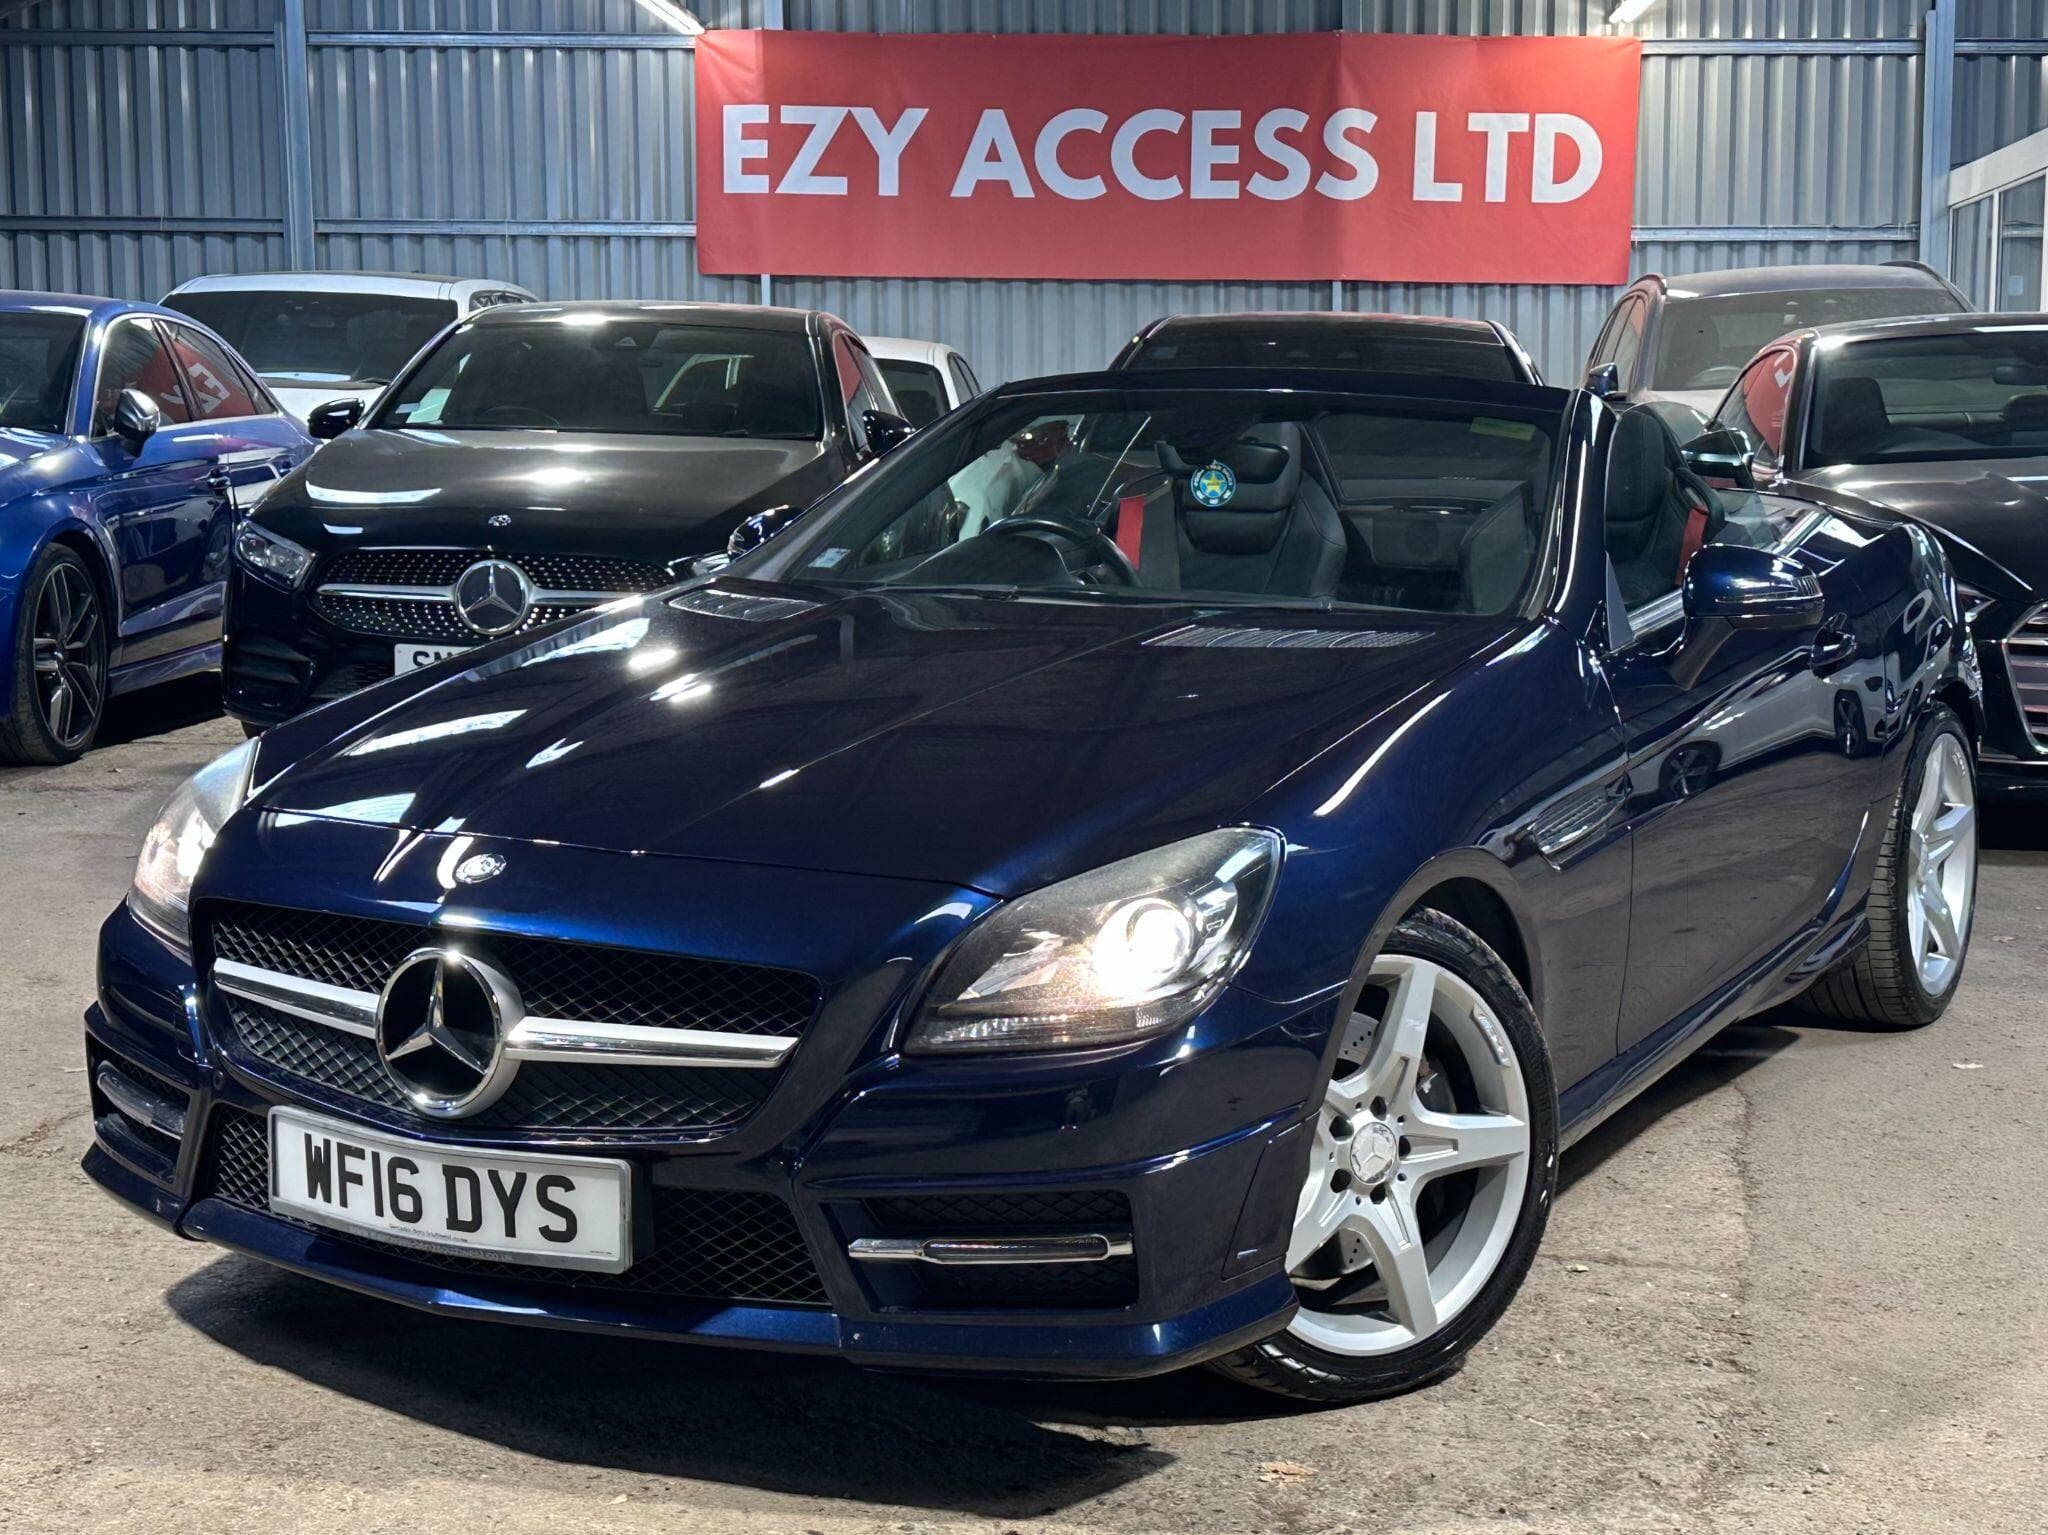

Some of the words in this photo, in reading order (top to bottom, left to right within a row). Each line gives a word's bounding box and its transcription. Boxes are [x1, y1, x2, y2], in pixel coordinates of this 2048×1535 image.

[722, 103, 930, 198] EZY
[950, 107, 1380, 202] ACCESS
[1412, 110, 1604, 204] LTD
[303, 1132, 424, 1225] WF16
[441, 1163, 578, 1244] DYS
